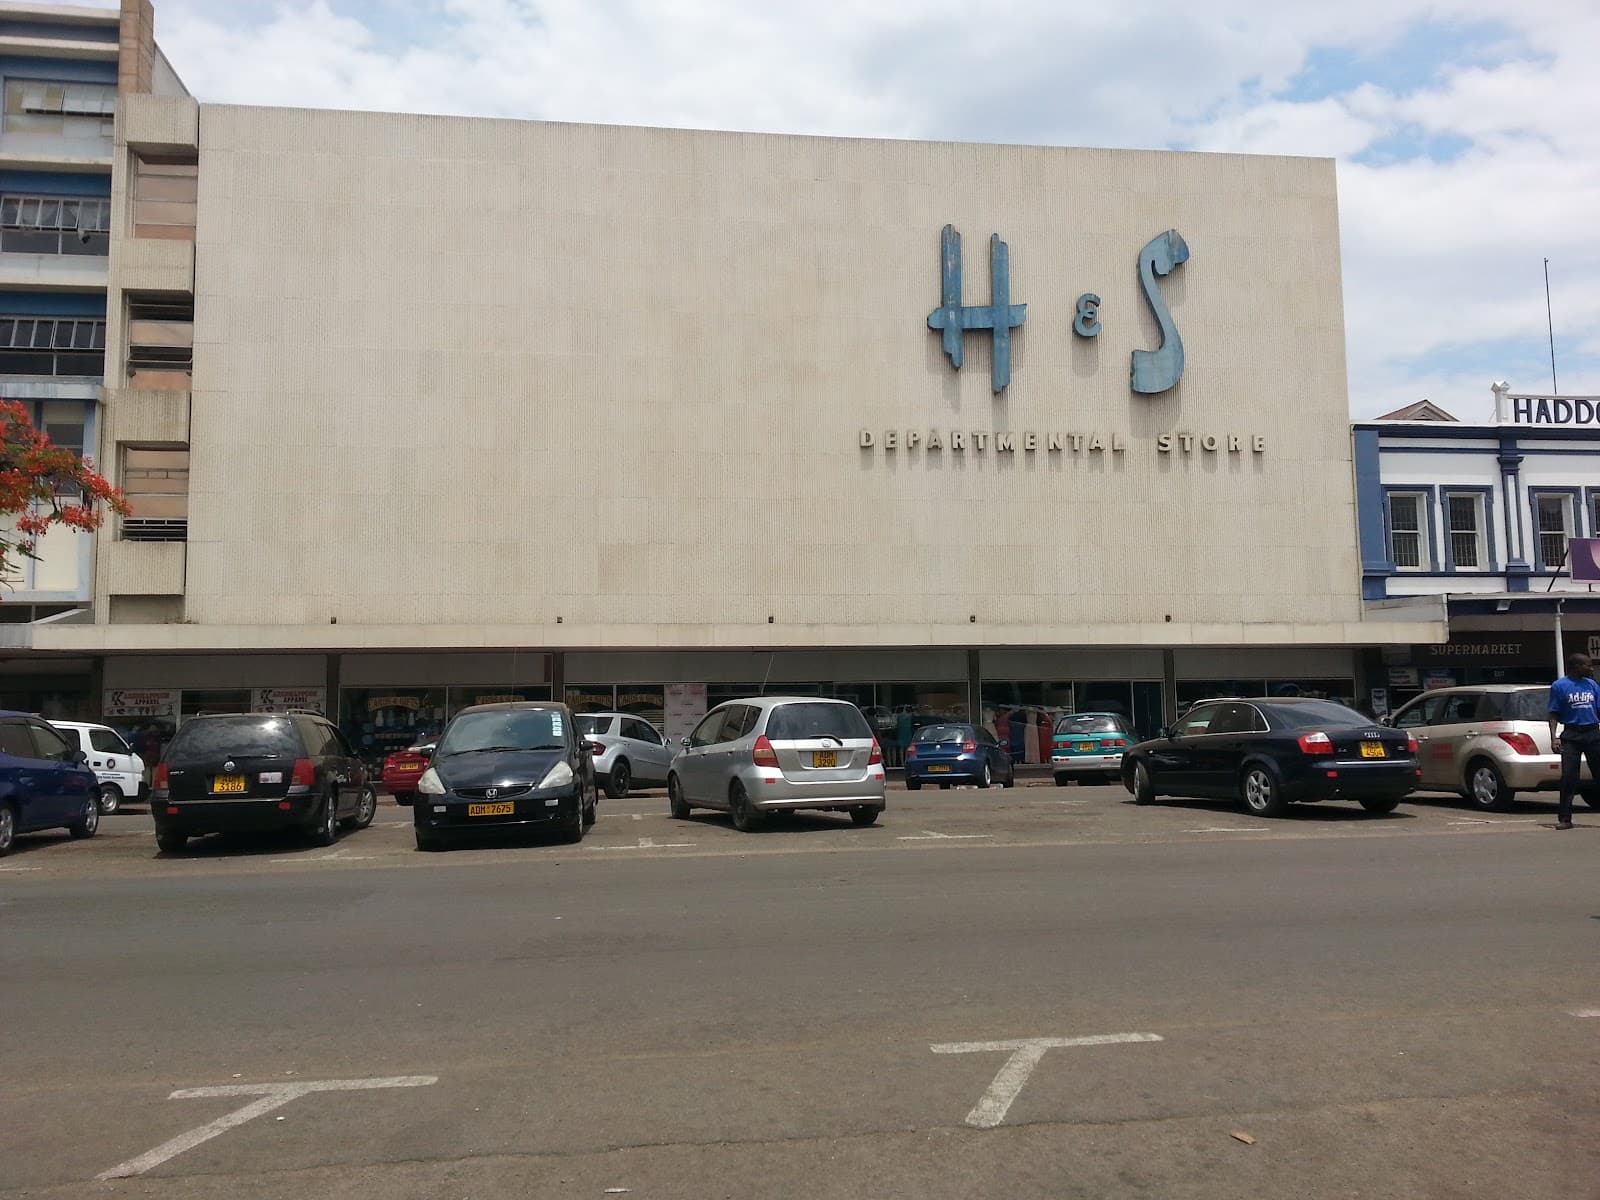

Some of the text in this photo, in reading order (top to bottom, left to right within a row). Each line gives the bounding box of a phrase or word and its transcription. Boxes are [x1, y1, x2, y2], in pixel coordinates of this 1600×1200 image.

[927, 223, 1027, 395] H
[1130, 228, 1190, 394] S
[1513, 398, 1600, 424] HADD
[859, 429, 1266, 453] DEPARTMENTAL STORE
[1431, 643, 1522, 656] SUPERMARKET
[219, 782, 243, 792] 3186
[491, 803, 512, 814] 7675
